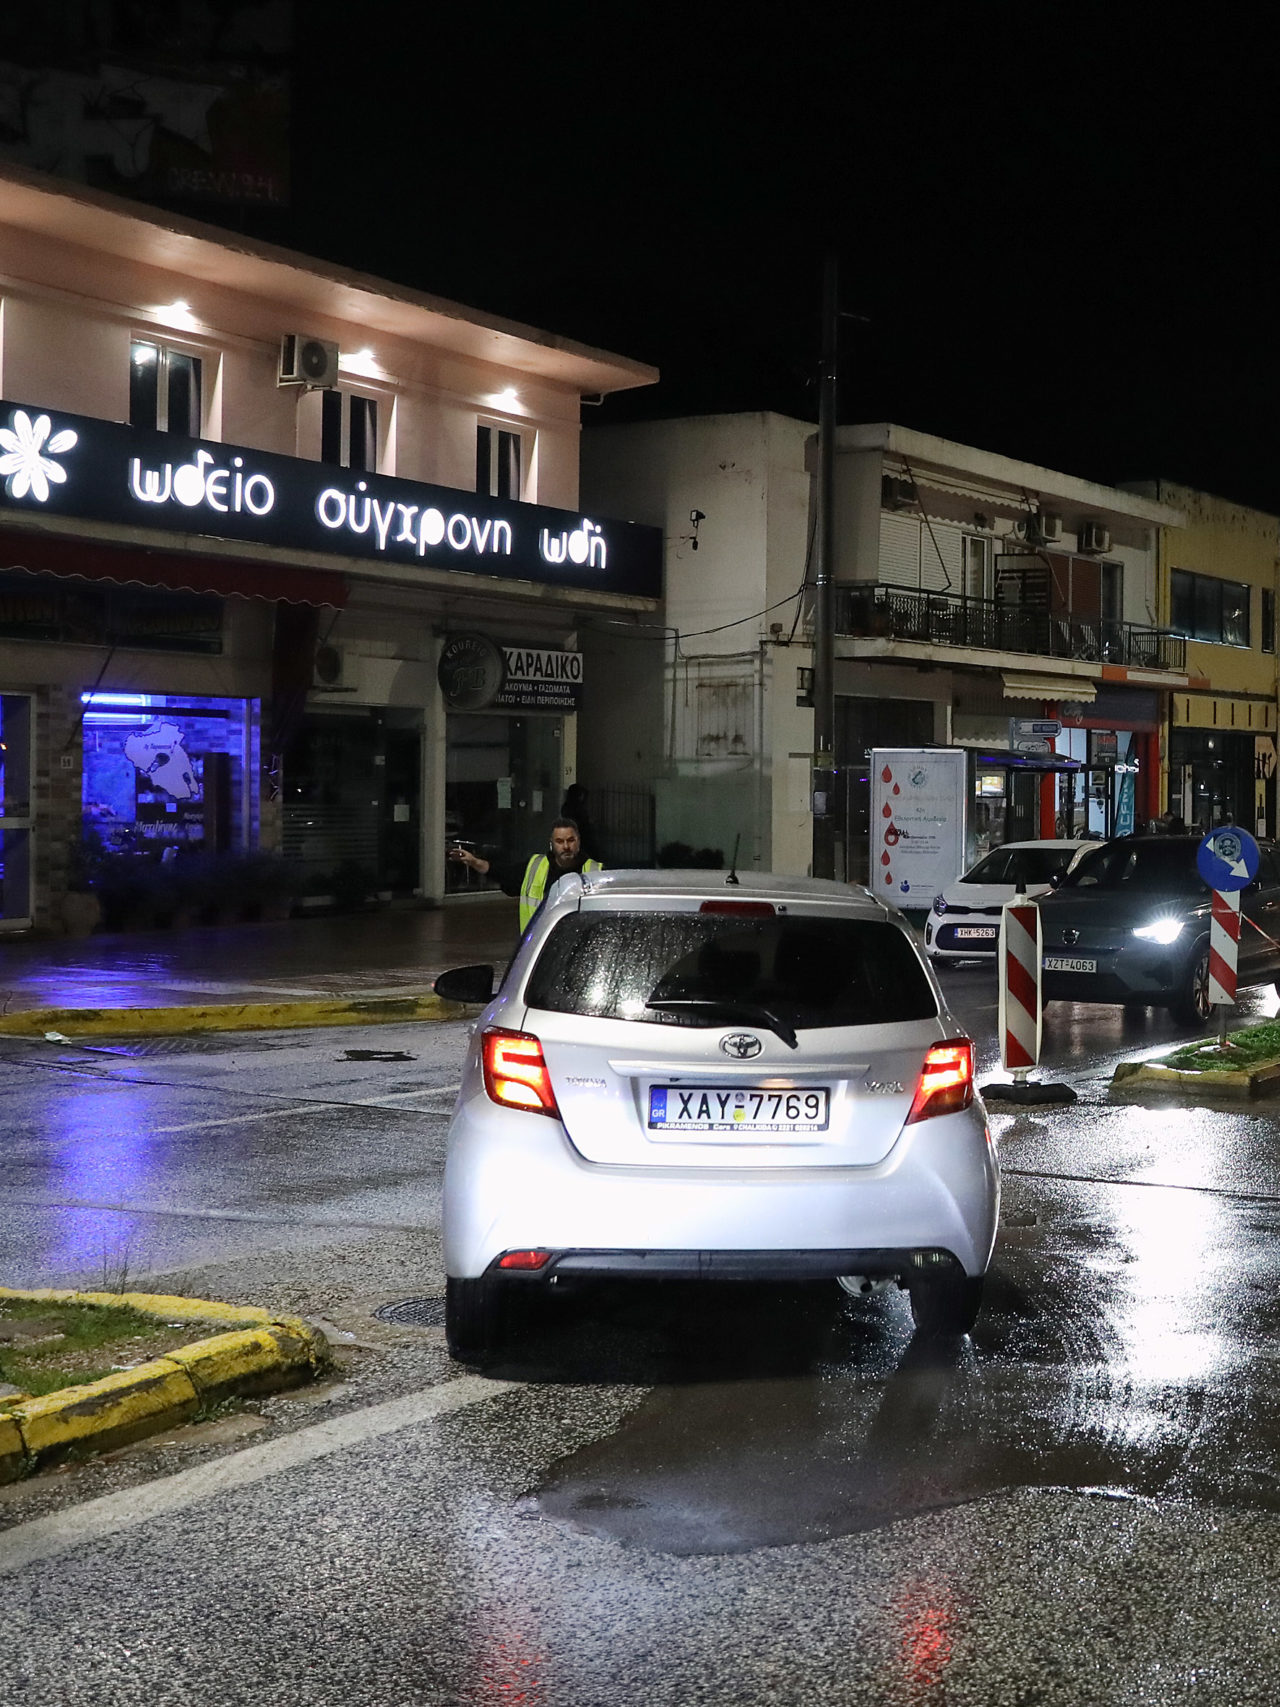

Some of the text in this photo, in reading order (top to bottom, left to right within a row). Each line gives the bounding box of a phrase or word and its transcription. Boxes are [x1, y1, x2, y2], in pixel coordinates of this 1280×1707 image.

[959, 929, 995, 938] XHK-5263
[1047, 959, 1094, 972] XZT-4063
[677, 1091, 822, 1120] XAY-7769
[652, 1109, 666, 1119] GR
